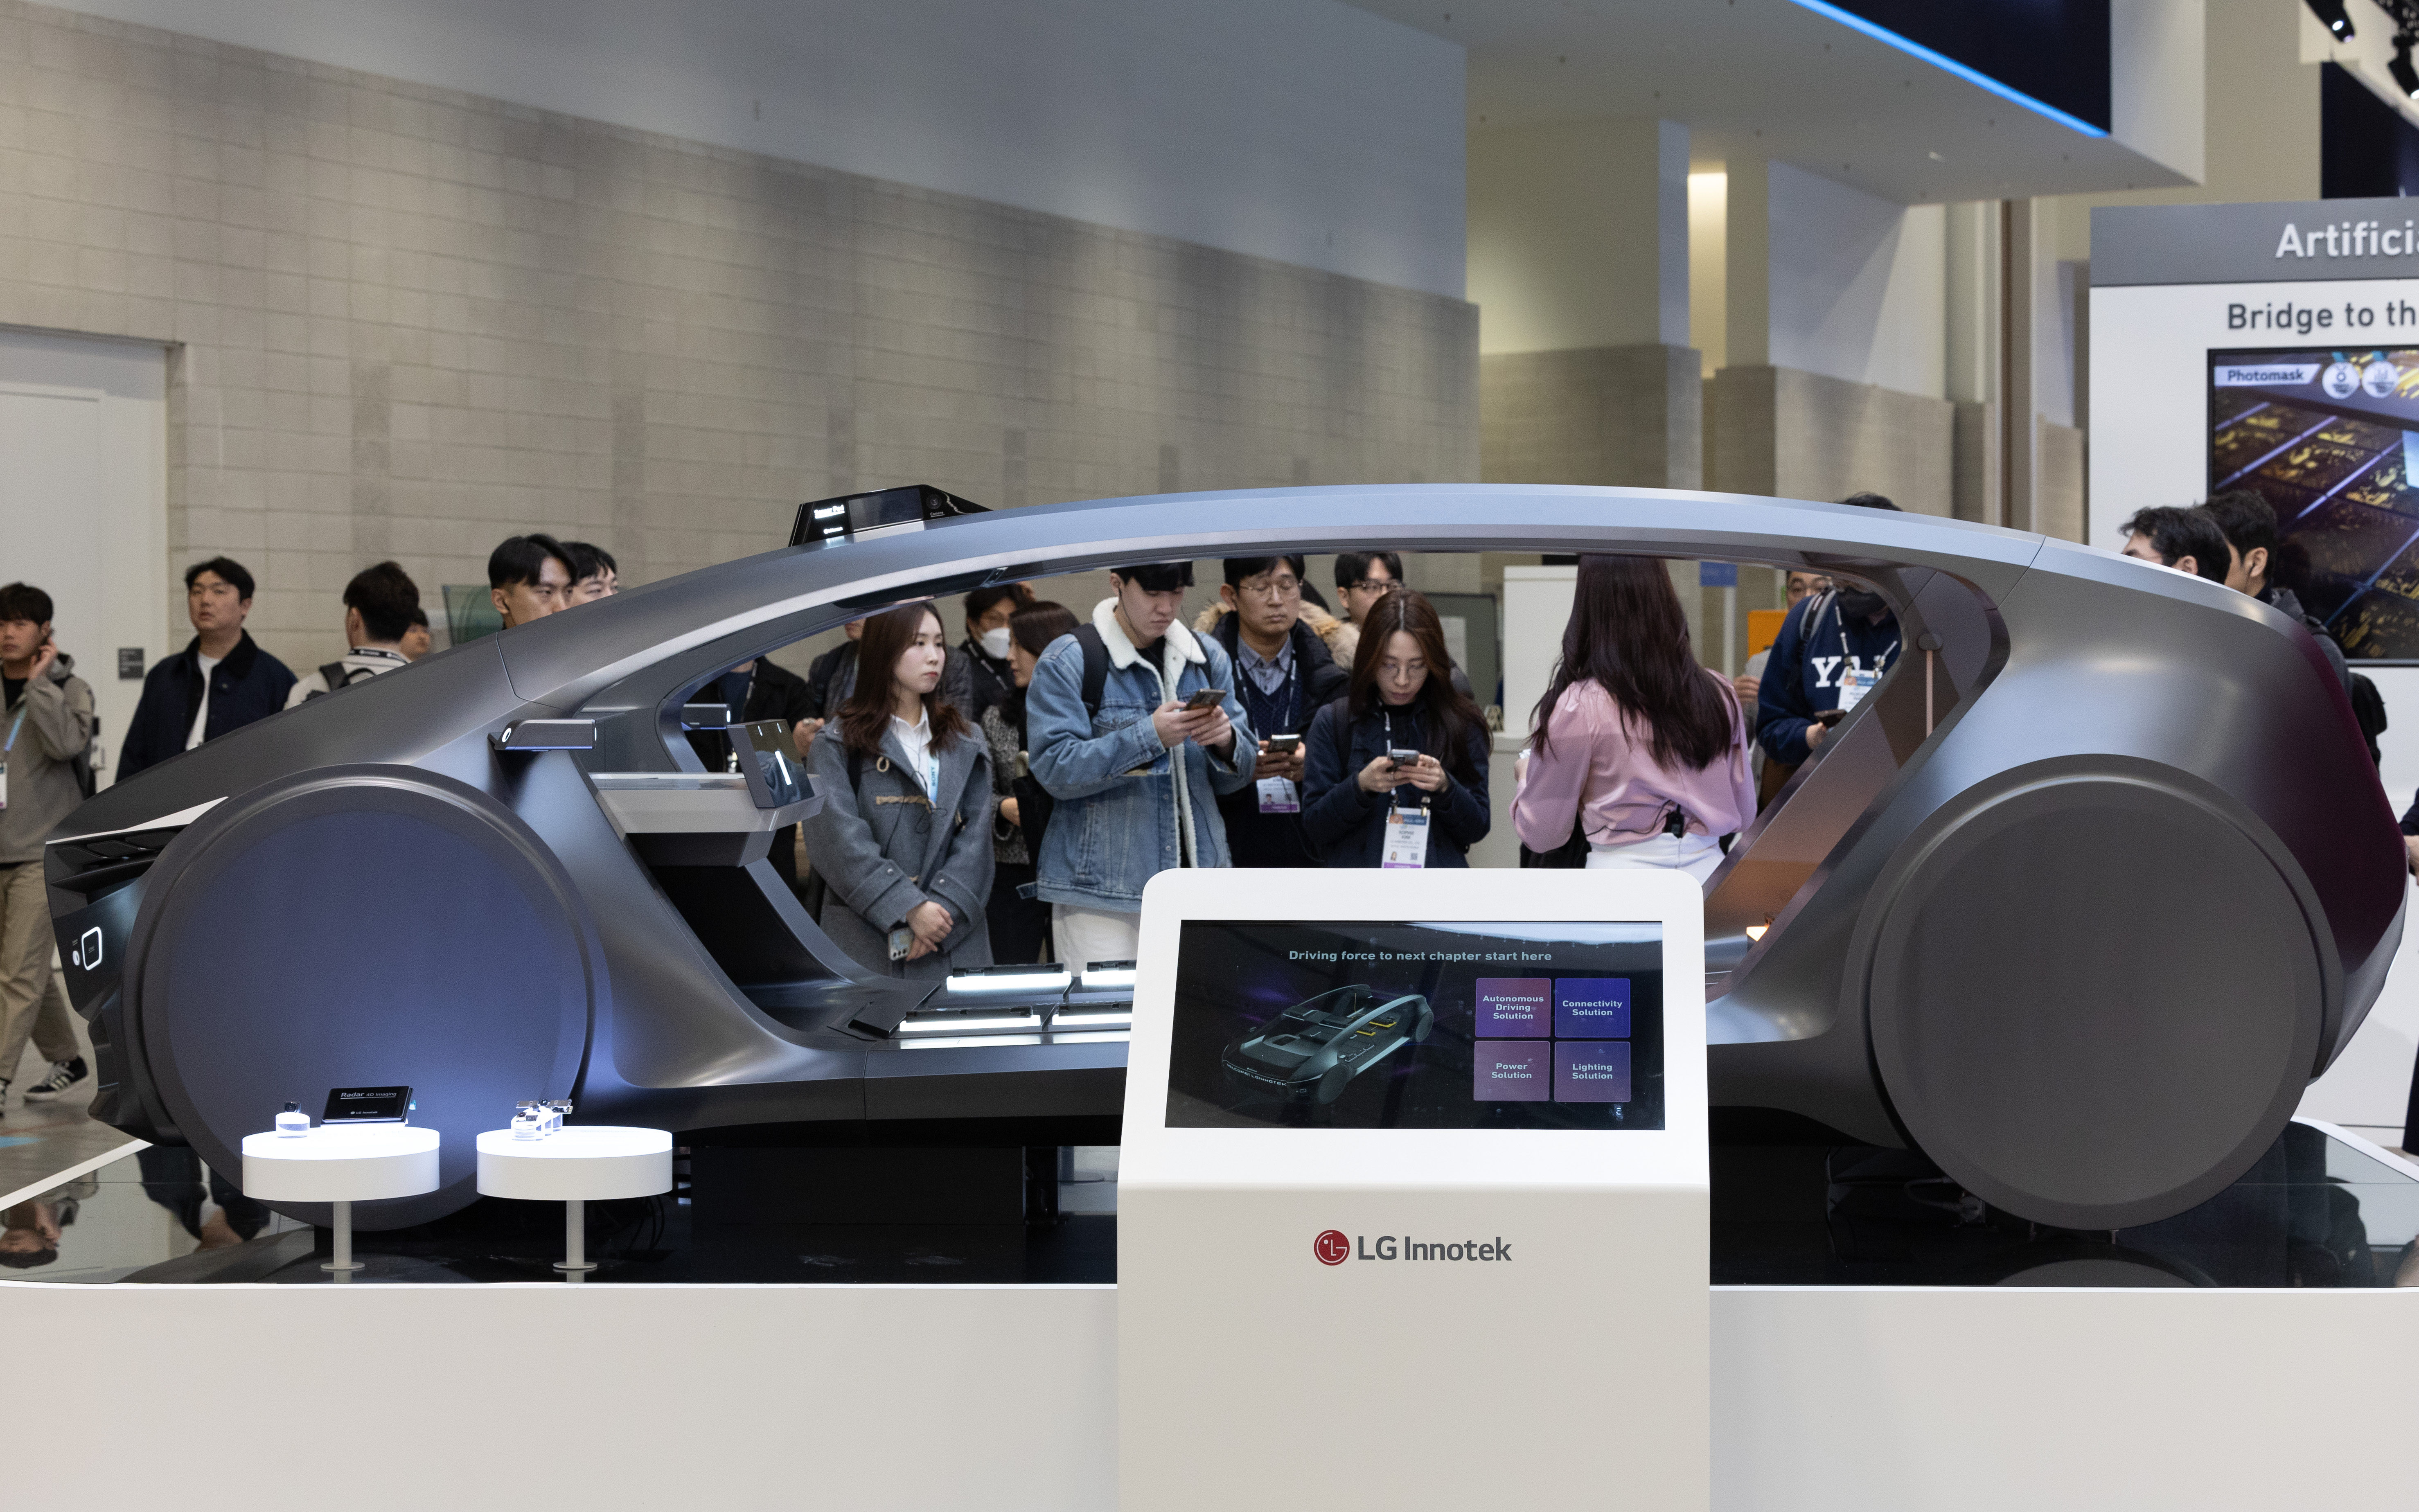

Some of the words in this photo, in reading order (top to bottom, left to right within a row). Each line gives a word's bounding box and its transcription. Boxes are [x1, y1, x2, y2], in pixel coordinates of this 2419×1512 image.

[2275, 220, 2419, 258] Artifici
[2227, 301, 2333, 335] Bridge
[2345, 302, 2374, 327] to
[2228, 369, 2304, 381] Photomask
[1289, 951, 1337, 962] Driving
[1341, 951, 1375, 960] force
[1380, 952, 1392, 960] to
[1396, 952, 1425, 960] next
[1429, 951, 1481, 962] chapter
[1485, 952, 1517, 960] start
[1522, 951, 1552, 960] here
[1496, 1004, 1531, 1012] Driving
[1562, 1000, 1623, 1008] Connectivity
[1572, 1064, 1613, 1072] Lighting
[1358, 1236, 1397, 1260] LG
[1405, 1236, 1512, 1261] Innotek
